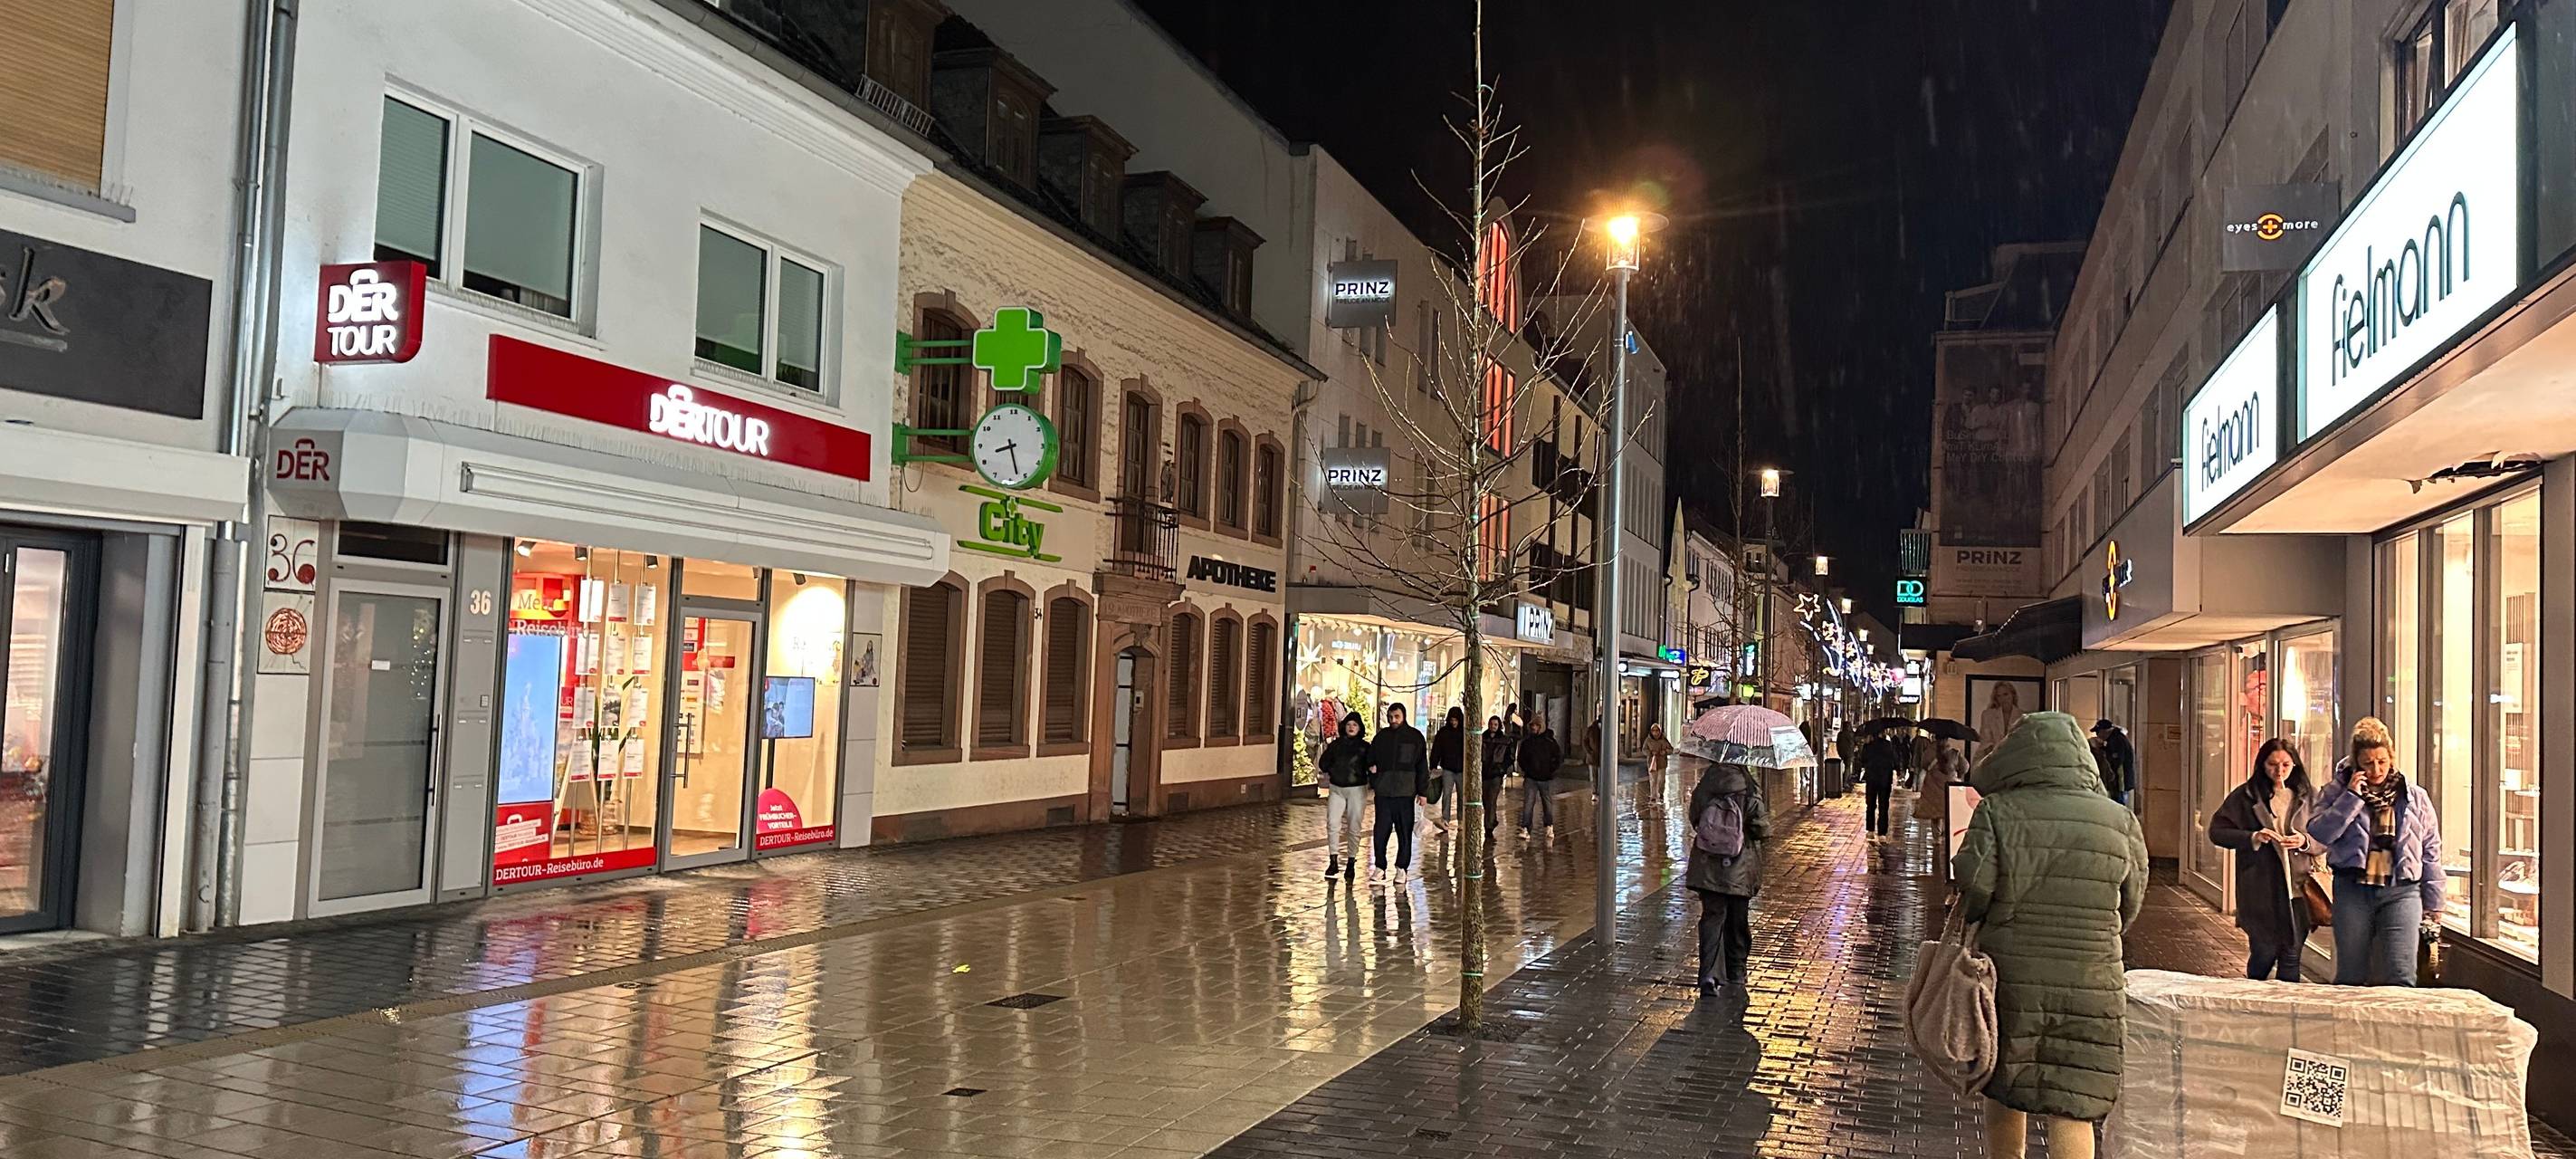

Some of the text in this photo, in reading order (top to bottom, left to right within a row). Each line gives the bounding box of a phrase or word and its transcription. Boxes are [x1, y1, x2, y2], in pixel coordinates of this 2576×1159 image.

[2227, 220, 2318, 234] eyes more
[328, 274, 398, 323] DER
[1335, 282, 1388, 295] PRINZ
[2332, 191, 2470, 387] fielmann
[328, 324, 396, 356] TOUR
[648, 389, 769, 455] DERTOUR
[2201, 390, 2259, 493] fielmann
[276, 447, 330, 482] DER
[1328, 469, 1381, 482] PRINZ
[979, 499, 1045, 558] City
[269, 533, 315, 585] 36
[1187, 555, 1276, 593] APOTHEKE
[470, 589, 491, 616] 36
[1529, 608, 1555, 639] PRINZ
[760, 828, 833, 846] DERTOUR-Reisebüro.de
[495, 857, 604, 881] DERTOUR-Reisebüro.de
